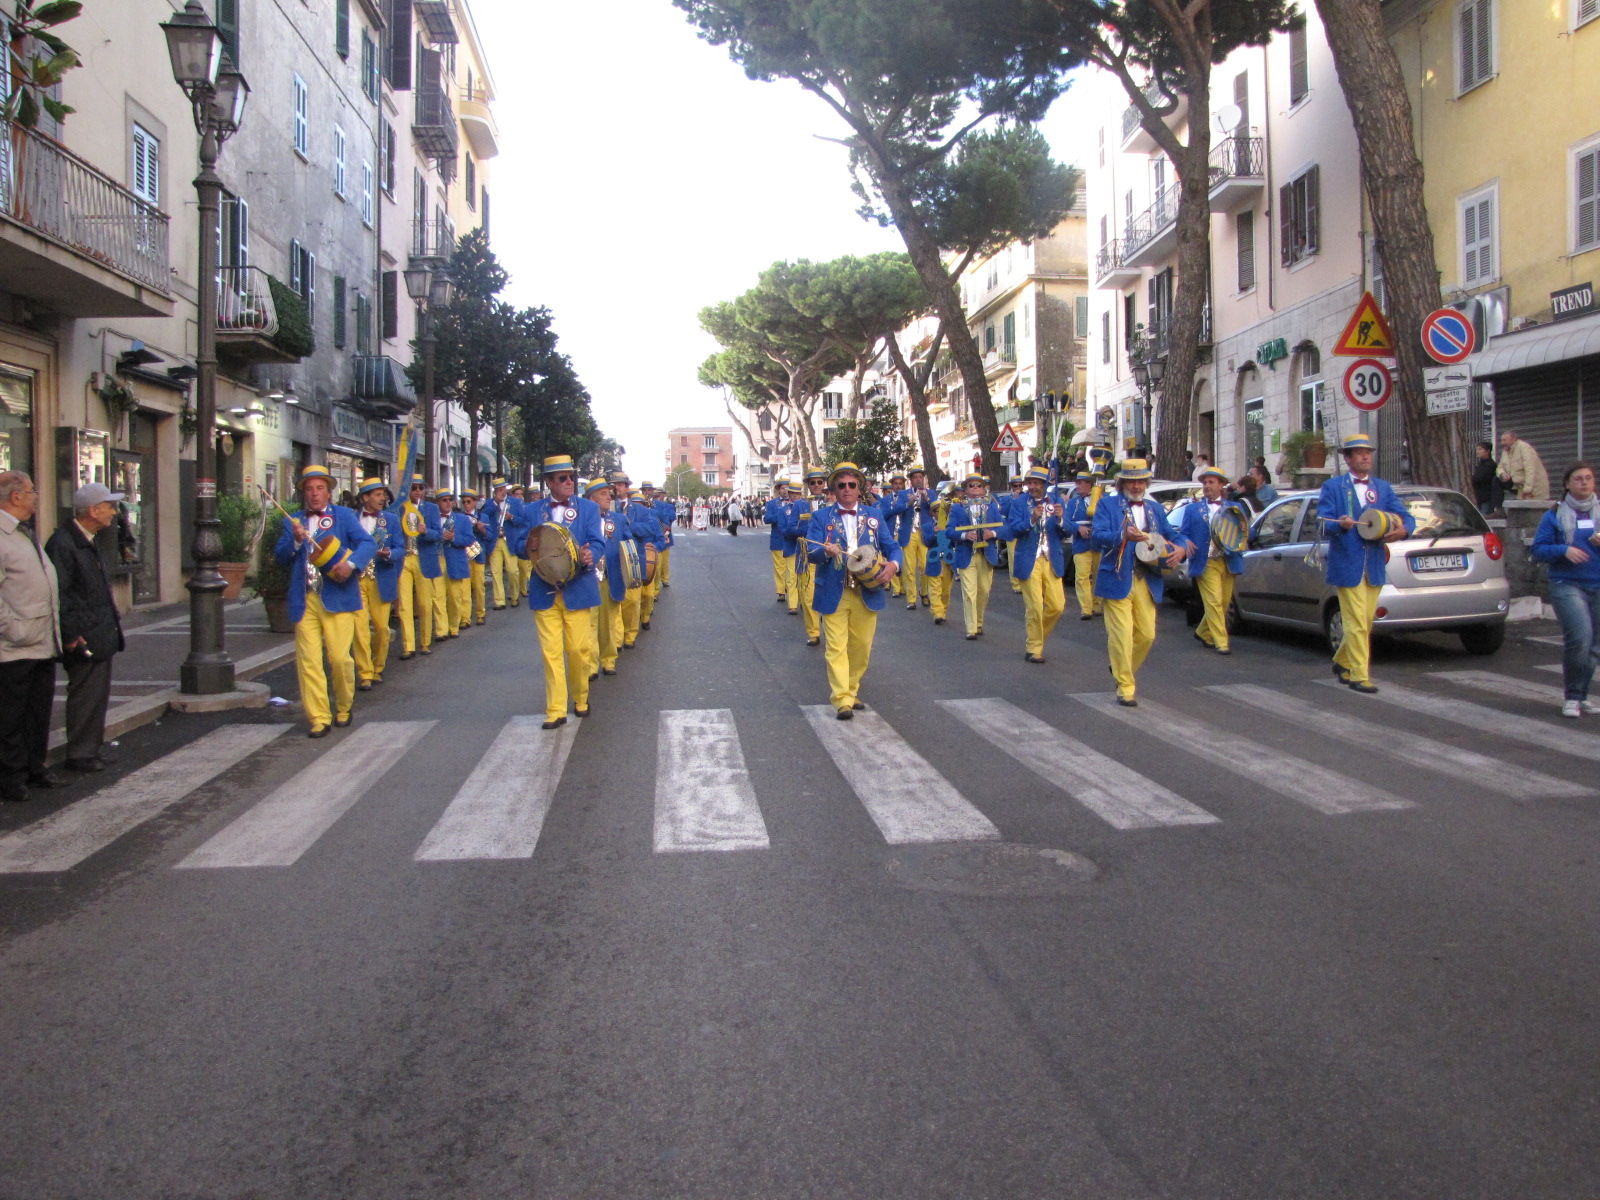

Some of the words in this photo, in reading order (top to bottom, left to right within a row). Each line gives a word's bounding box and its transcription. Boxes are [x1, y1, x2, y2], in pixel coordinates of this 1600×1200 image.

[1552, 289, 1592, 314] TREND
[1355, 372, 1382, 397] 30
[1418, 557, 1430, 568] DE
